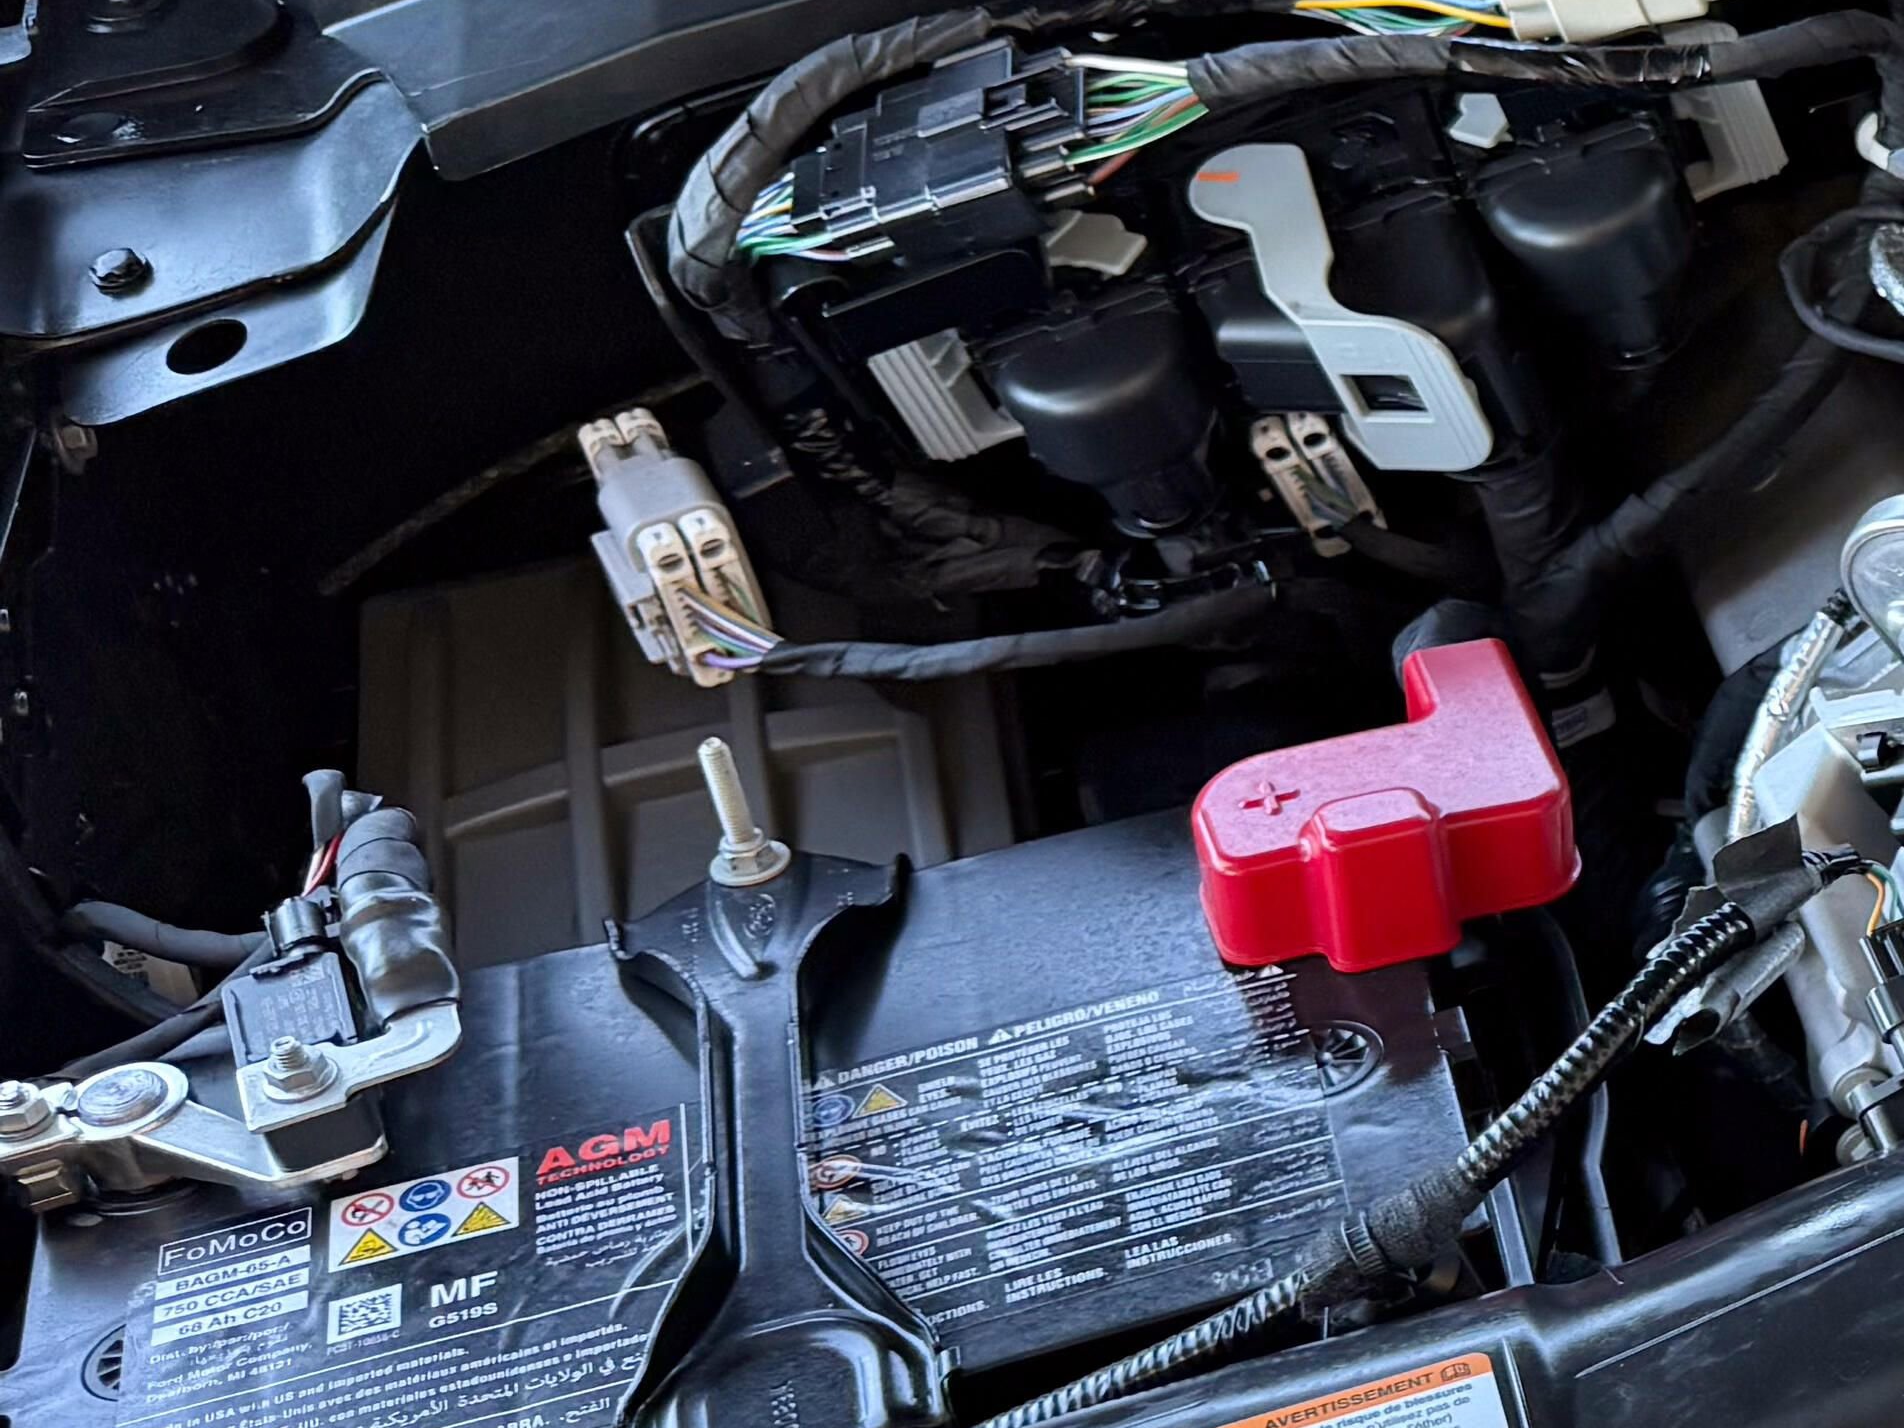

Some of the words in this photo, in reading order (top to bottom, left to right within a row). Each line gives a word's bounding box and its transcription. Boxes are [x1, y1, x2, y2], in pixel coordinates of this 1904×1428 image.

[835, 1037, 980, 1083] DANGER/POISON
[1011, 991, 1161, 1036] PELIGRO/VENENO
[530, 1118, 674, 1175] AGM
[534, 1144, 671, 1186] TECHNOLOGY
[533, 1163, 660, 1201] NON-SPILLABLE
[160, 1217, 308, 1267] FoMoCo
[161, 1300, 198, 1317] 750
[202, 1273, 303, 1306] CCA/SAE
[430, 1271, 498, 1311] MF
[426, 1301, 499, 1330] G519S
[185, 1416, 201, 1428] in
[203, 1406, 236, 1423] USA
[272, 1390, 295, 1405] US
[297, 1382, 324, 1398] and
[326, 1365, 394, 1391] imported
